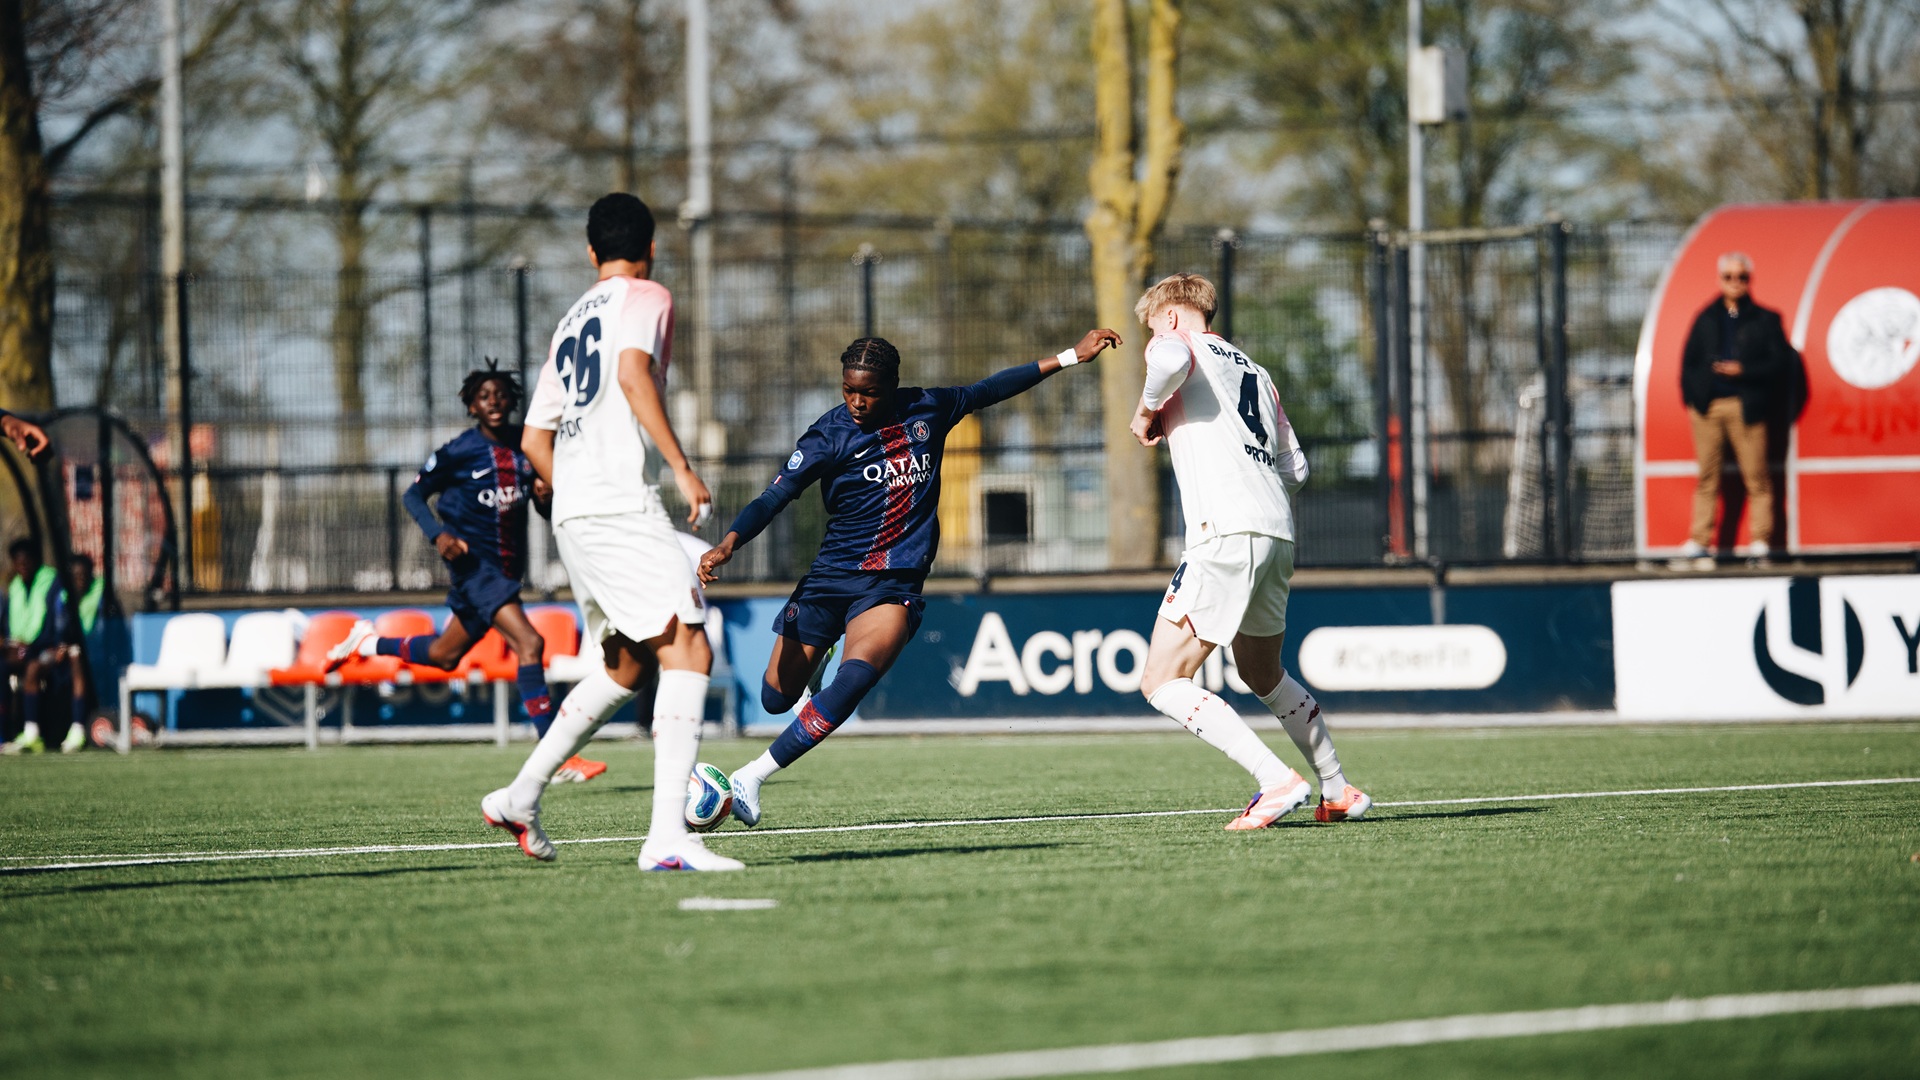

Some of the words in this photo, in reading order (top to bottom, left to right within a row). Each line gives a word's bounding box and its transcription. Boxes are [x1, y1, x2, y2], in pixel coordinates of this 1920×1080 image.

[556, 317, 602, 407] 26
[1237, 371, 1268, 448] 4
[863, 453, 931, 484] QATAR
[883, 471, 931, 487] AIRWAYS
[1171, 561, 1188, 594] 4
[957, 611, 1256, 696] Acrois
